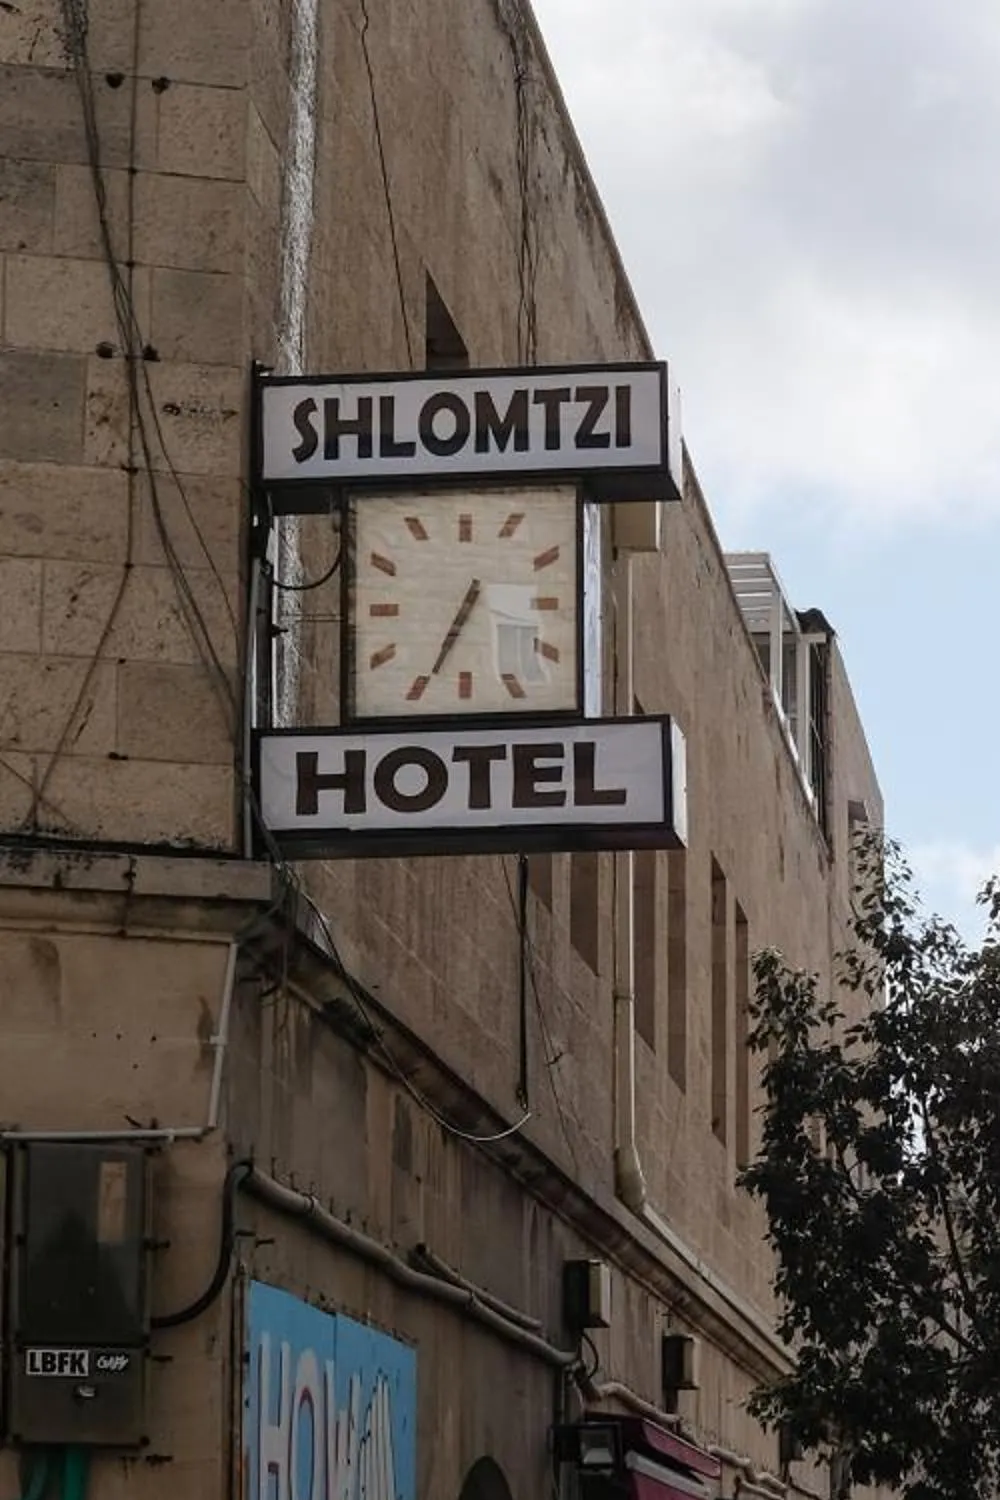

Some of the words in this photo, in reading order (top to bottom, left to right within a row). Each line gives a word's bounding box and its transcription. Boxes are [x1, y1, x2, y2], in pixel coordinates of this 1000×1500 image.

[291, 384, 632, 464] SHLOMTZI
[294, 741, 628, 816] HOTEL
[29, 1351, 86, 1374] LBFK
